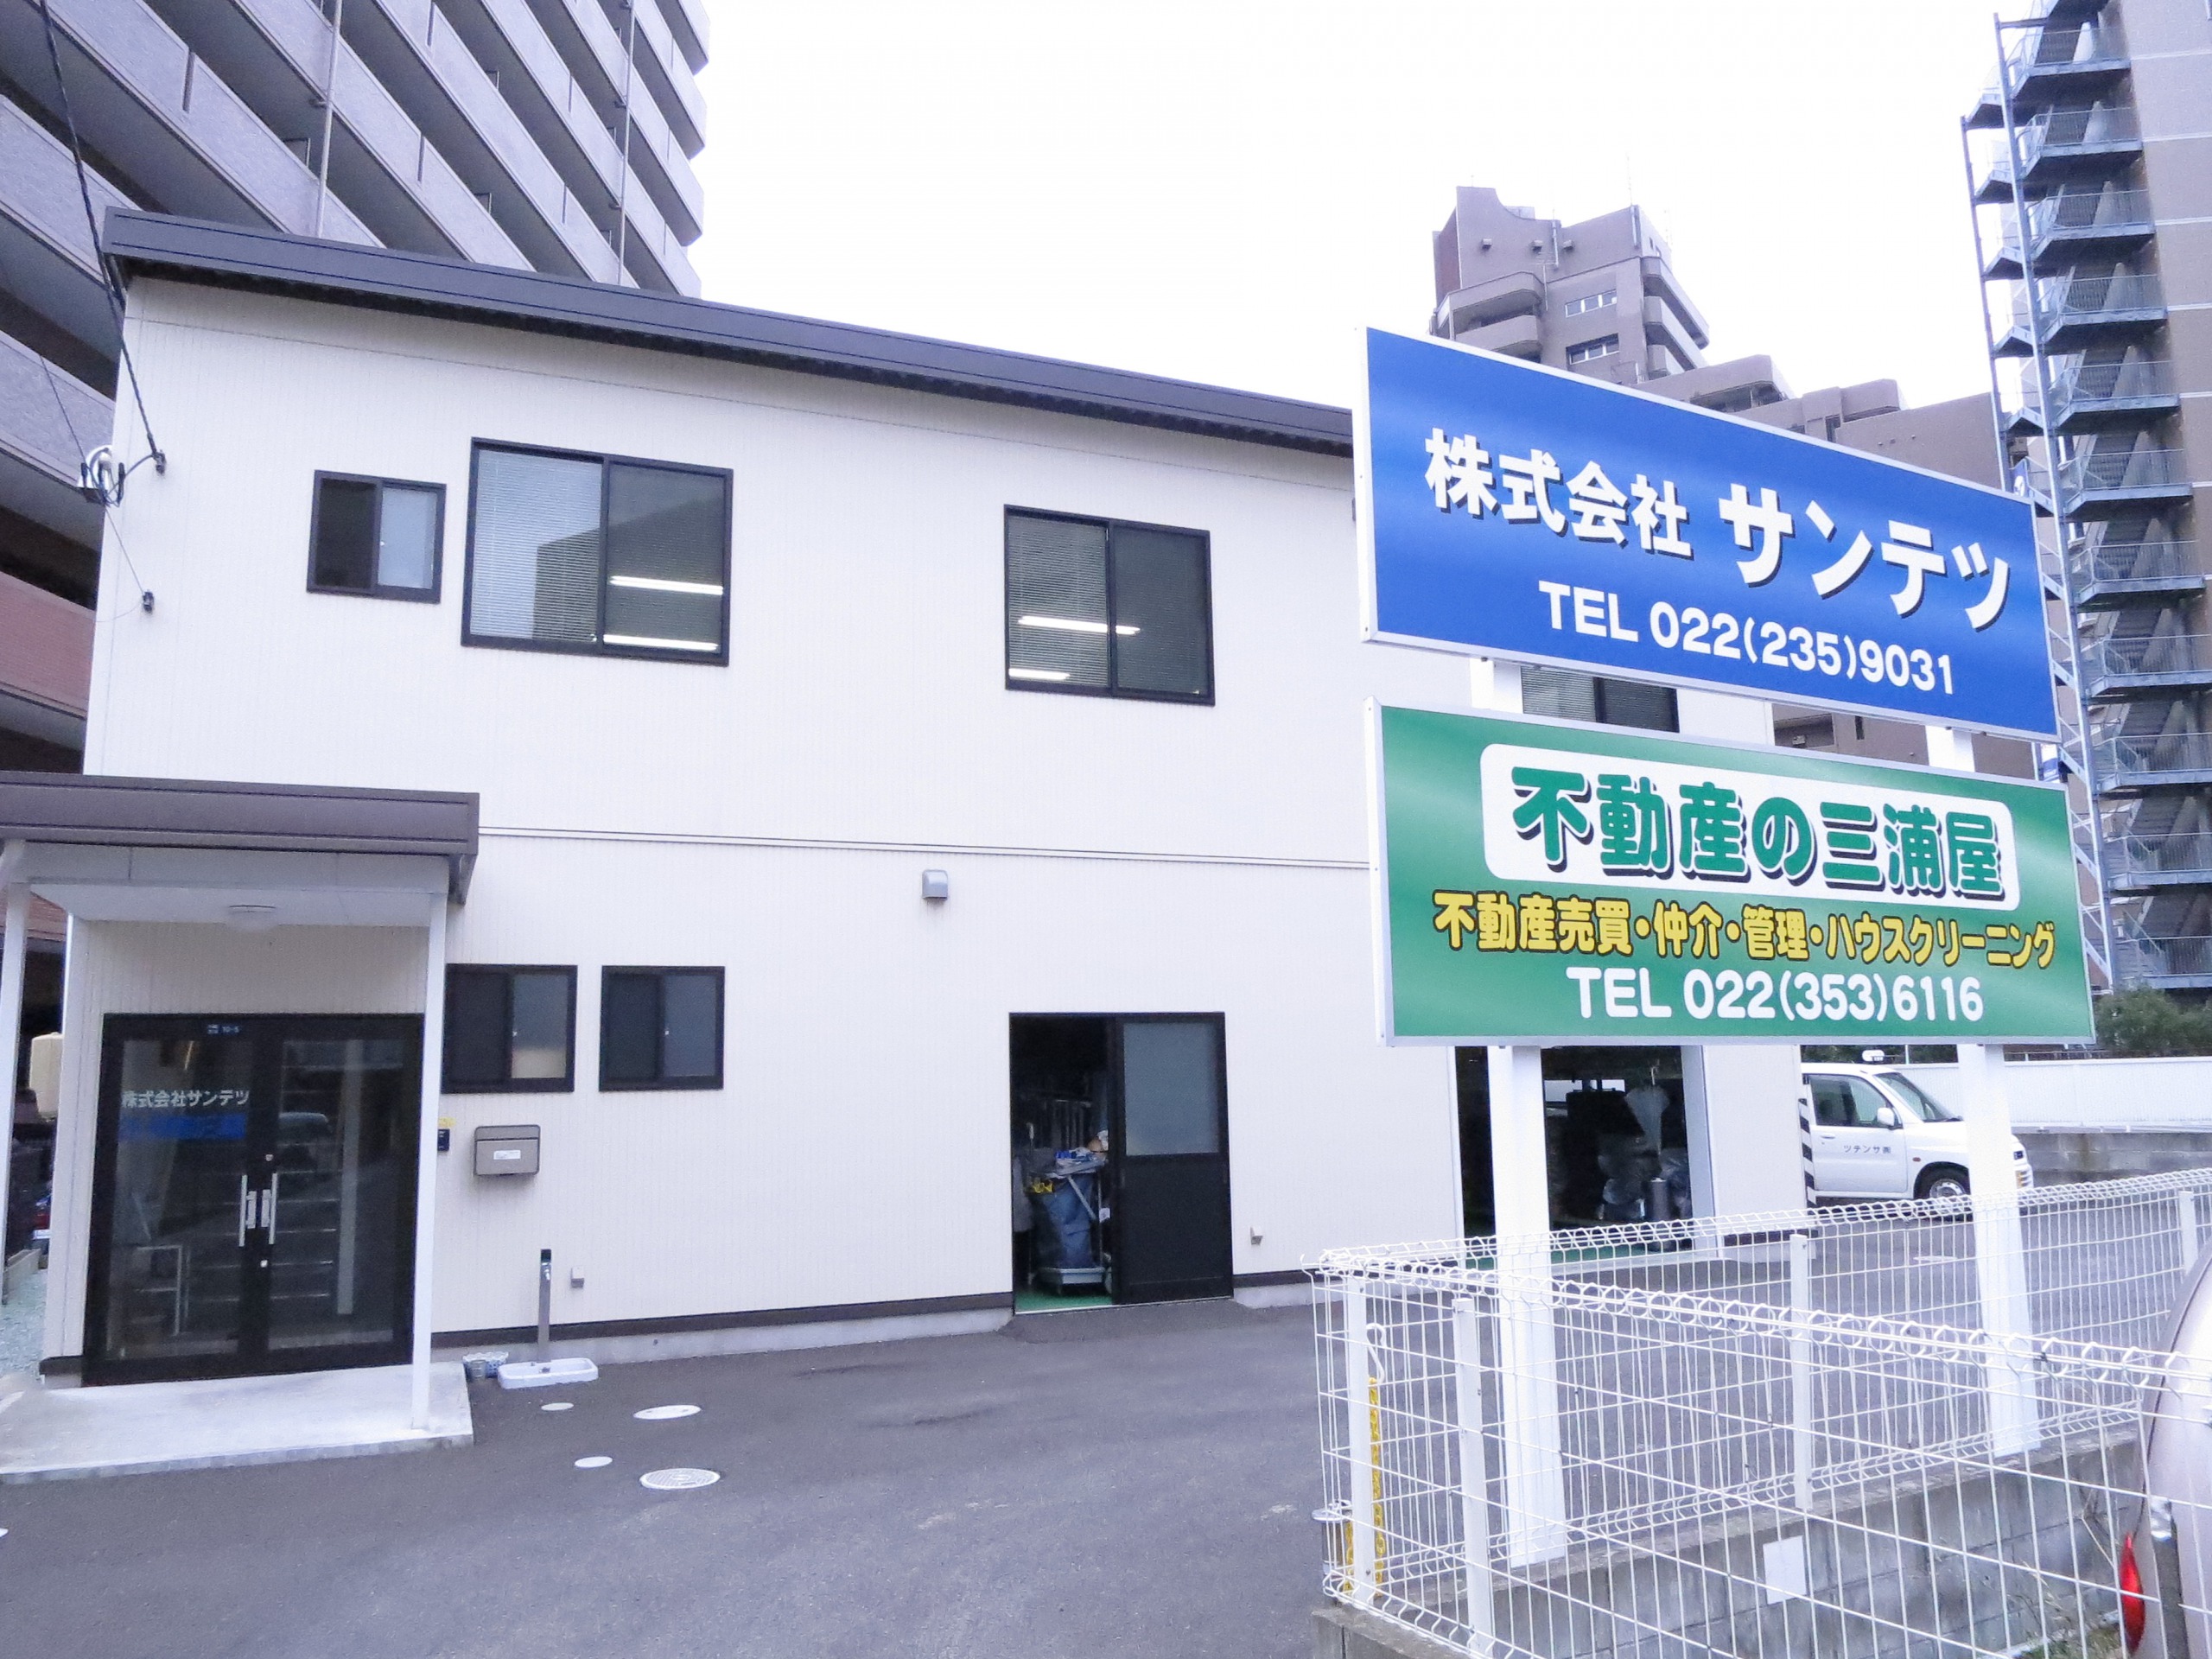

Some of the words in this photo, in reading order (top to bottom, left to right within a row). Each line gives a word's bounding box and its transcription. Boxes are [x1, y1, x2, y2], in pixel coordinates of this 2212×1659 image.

[1424, 427, 1693, 559] 株式会社
[1718, 482, 2010, 630] サンテツ
[1538, 580, 1640, 642] TEL
[1649, 600, 1954, 695] 022(235)9031
[1511, 766, 2005, 899] 不動産の三浦屋
[1566, 966, 1673, 1019] TEL
[1683, 968, 1985, 1022] 022(353)6116
[122, 1089, 251, 1109] 株式会社サンテツ
